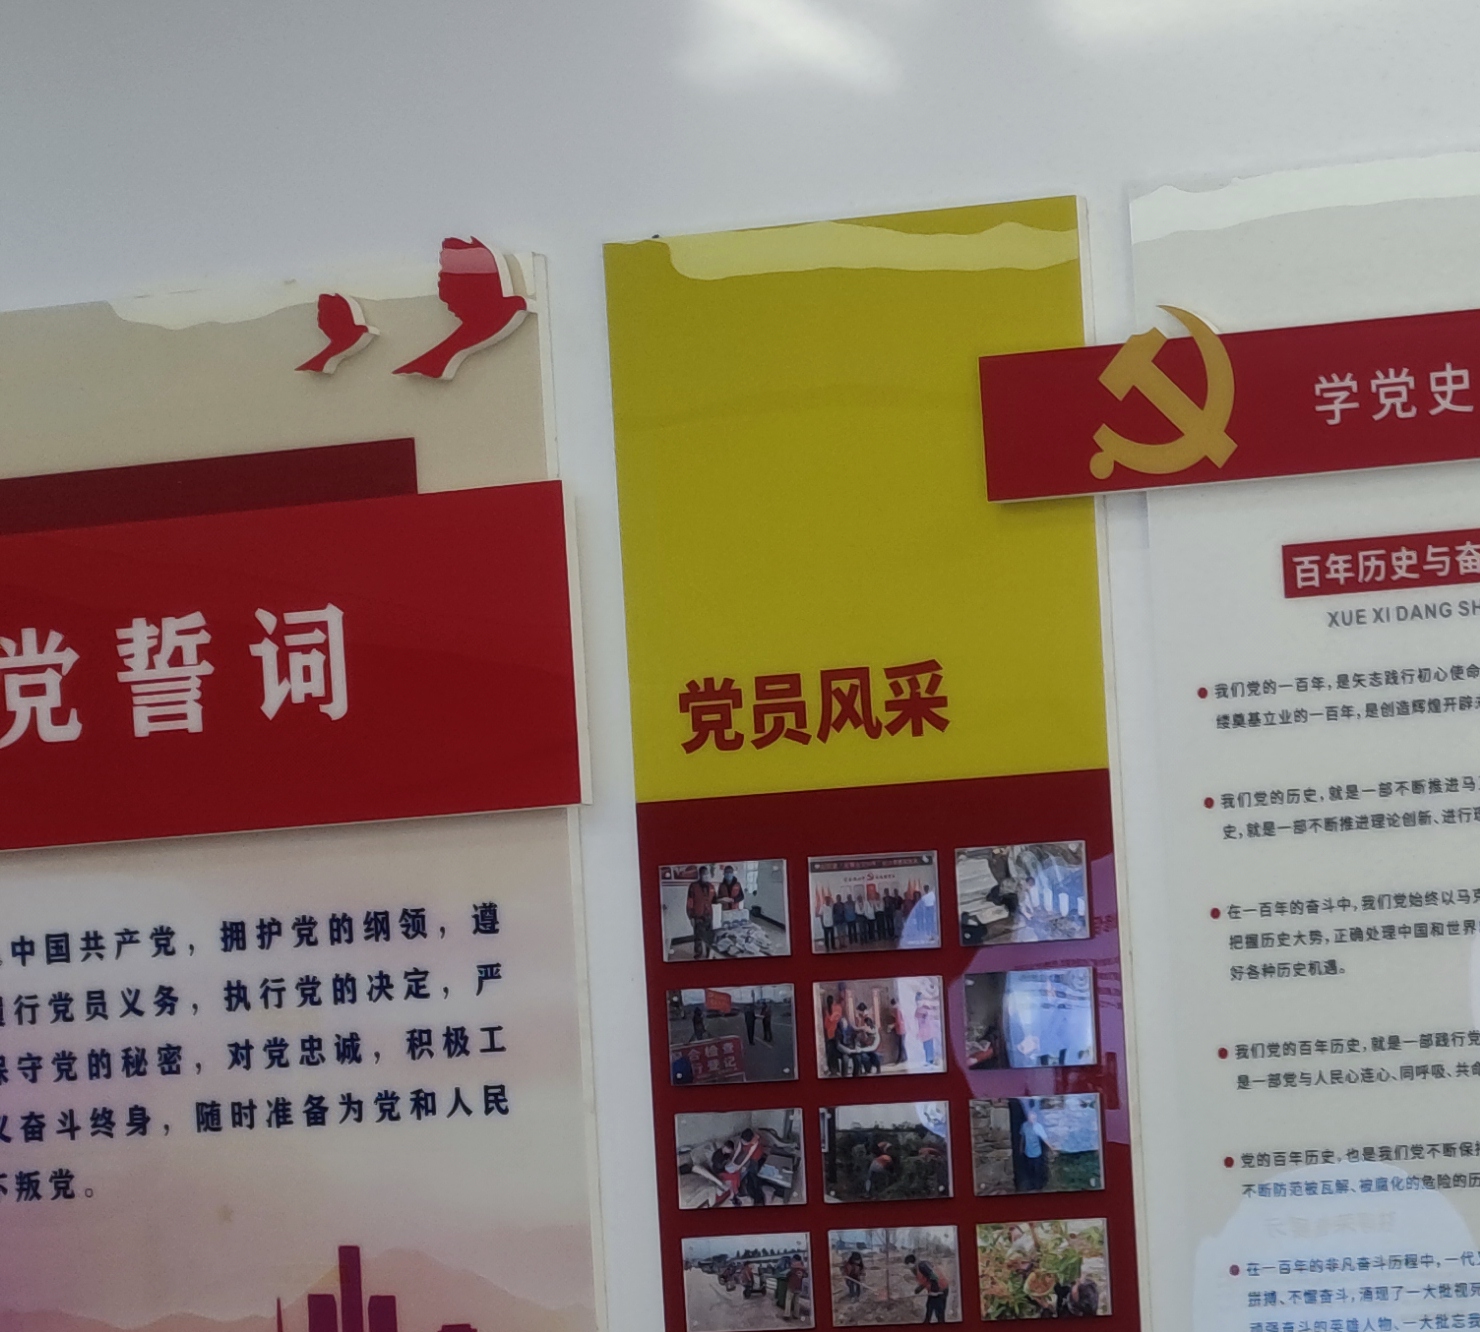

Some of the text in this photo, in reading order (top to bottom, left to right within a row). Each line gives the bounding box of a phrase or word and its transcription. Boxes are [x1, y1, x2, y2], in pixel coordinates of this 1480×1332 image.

[1314, 365, 1475, 426] 学党史
[1327, 608, 1367, 627] XUE
[1372, 606, 1391, 624] XI
[1396, 601, 1453, 622] DANG
[0, 603, 347, 749] 党誓词
[679, 660, 949, 753] 党员风采
[0, 902, 499, 966] 中国共产党，拥护党的纲领，遵
